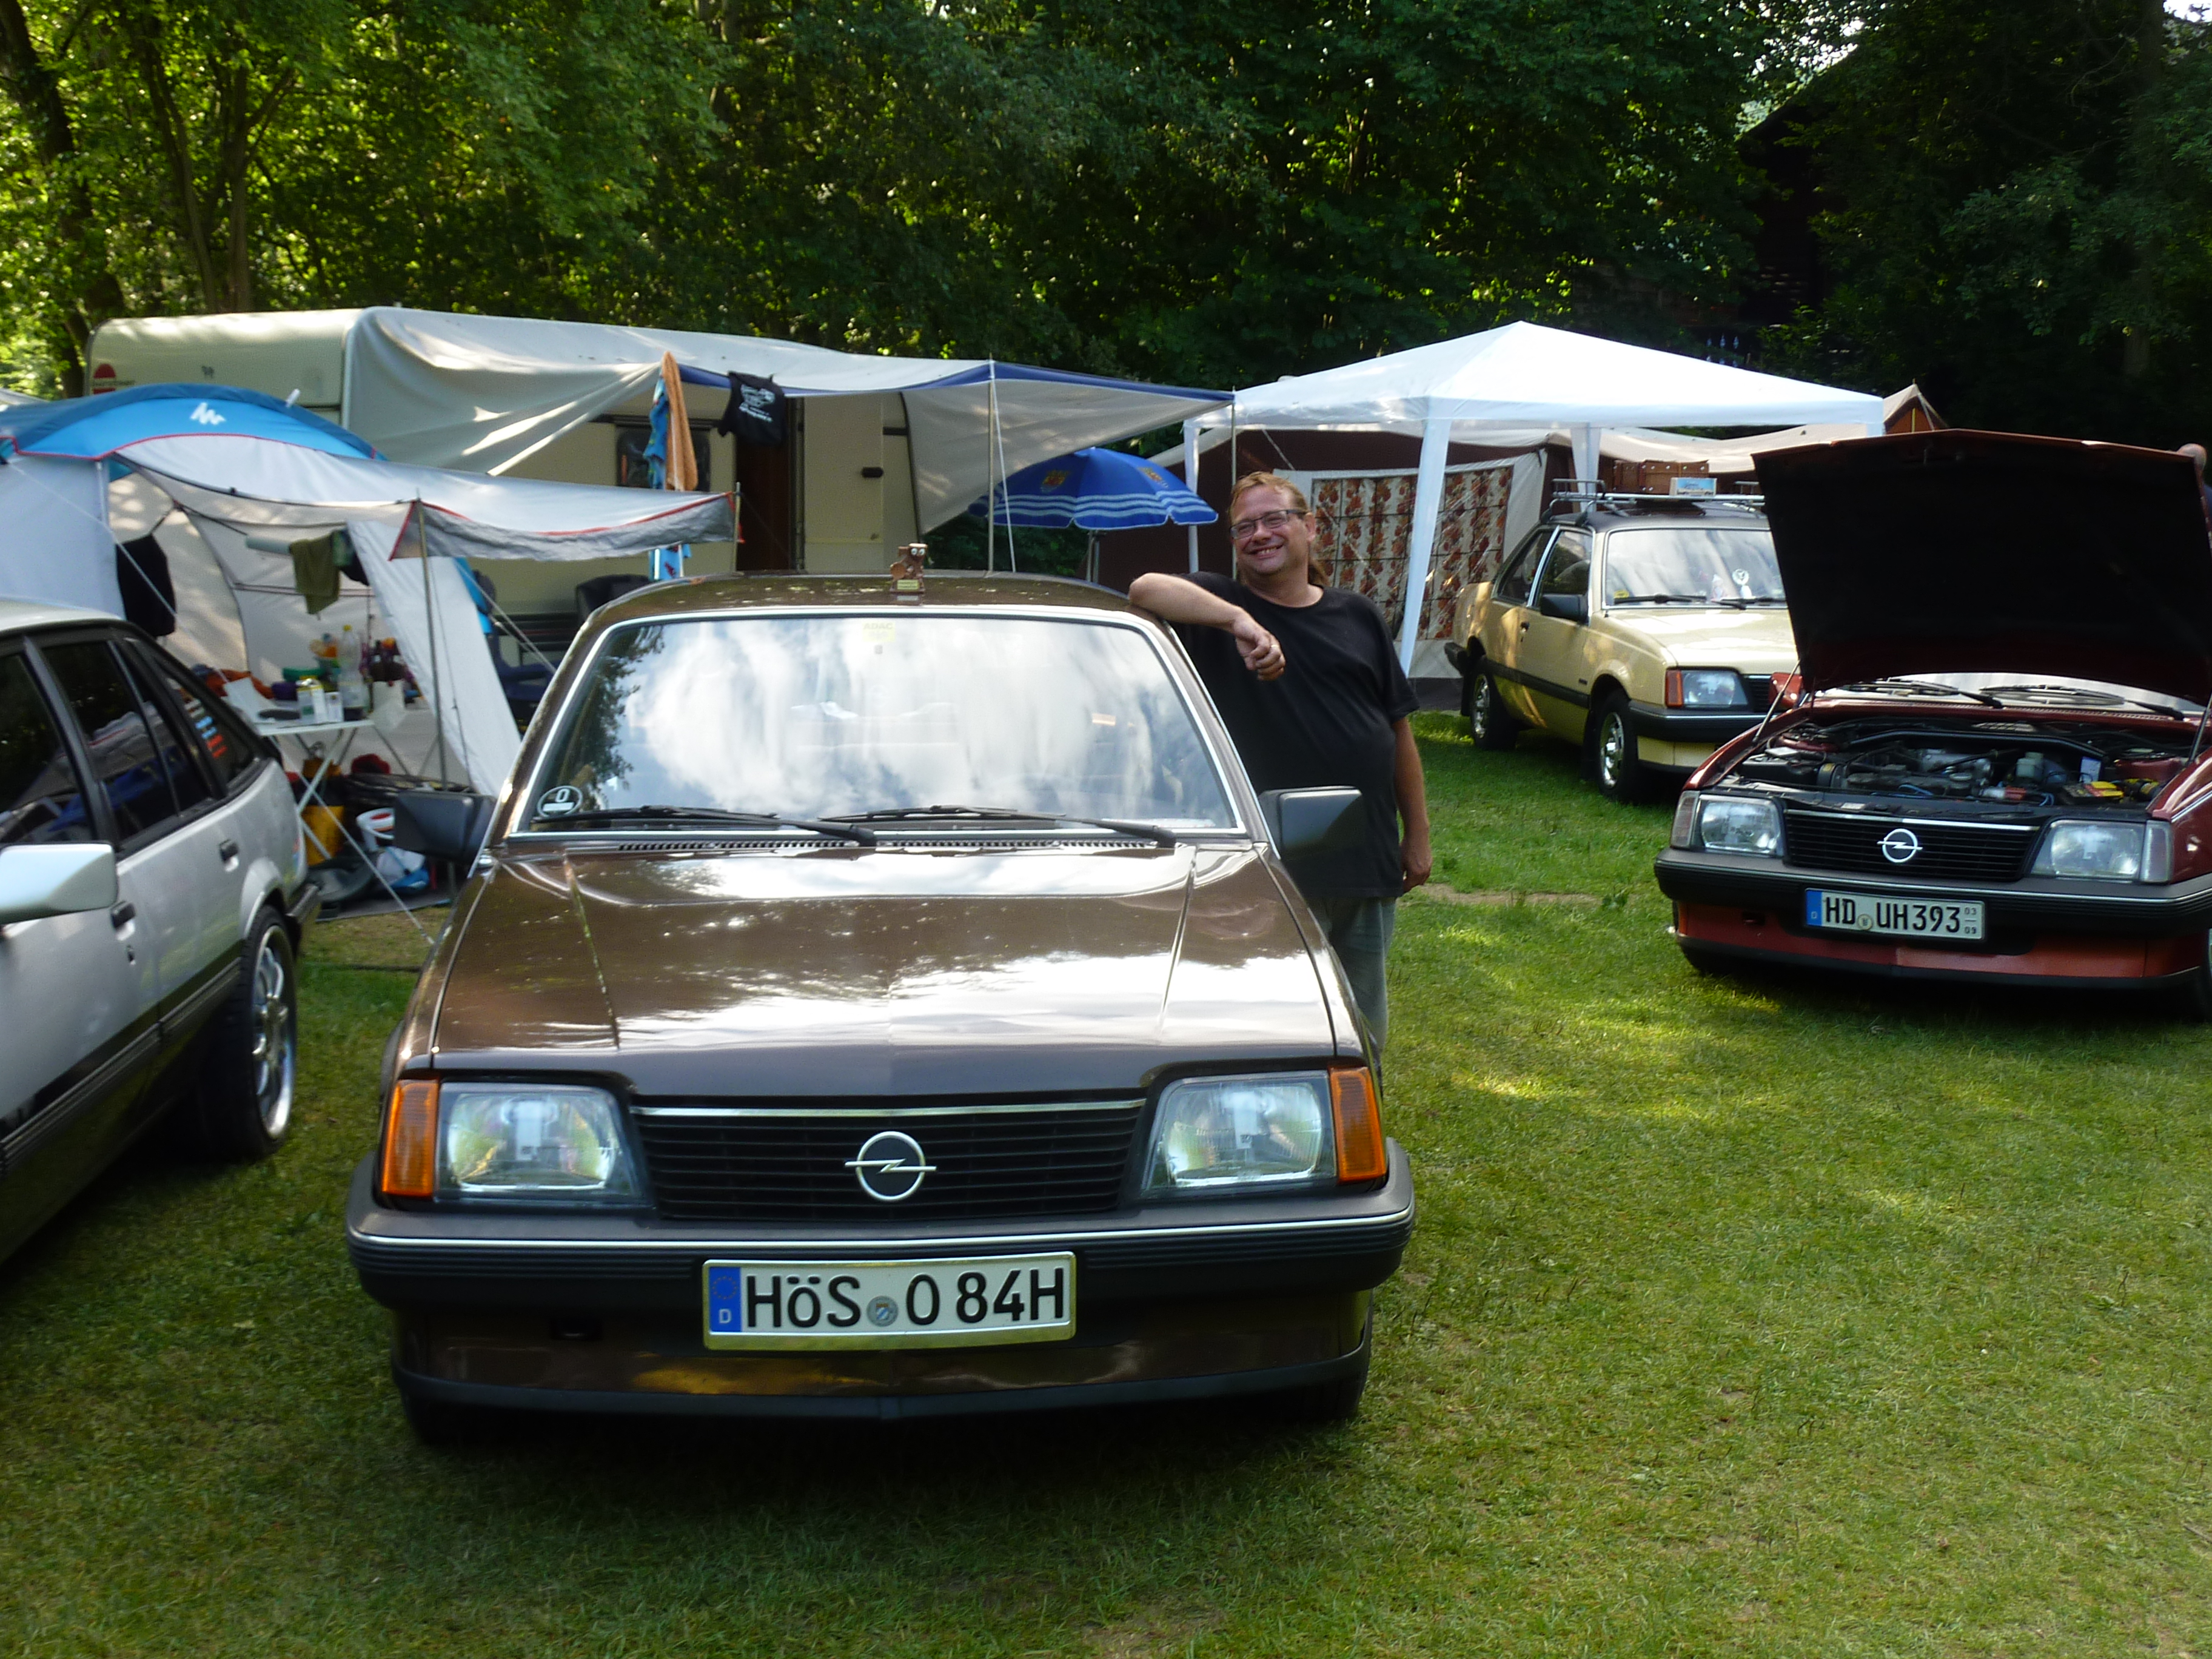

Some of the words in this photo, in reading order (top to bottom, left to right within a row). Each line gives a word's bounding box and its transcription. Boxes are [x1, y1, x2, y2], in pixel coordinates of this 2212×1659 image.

[1825, 896, 1856, 925] HD
[1965, 907, 1977, 916] 03
[955, 1267, 1065, 1324] 84H
[719, 1308, 732, 1324] D
